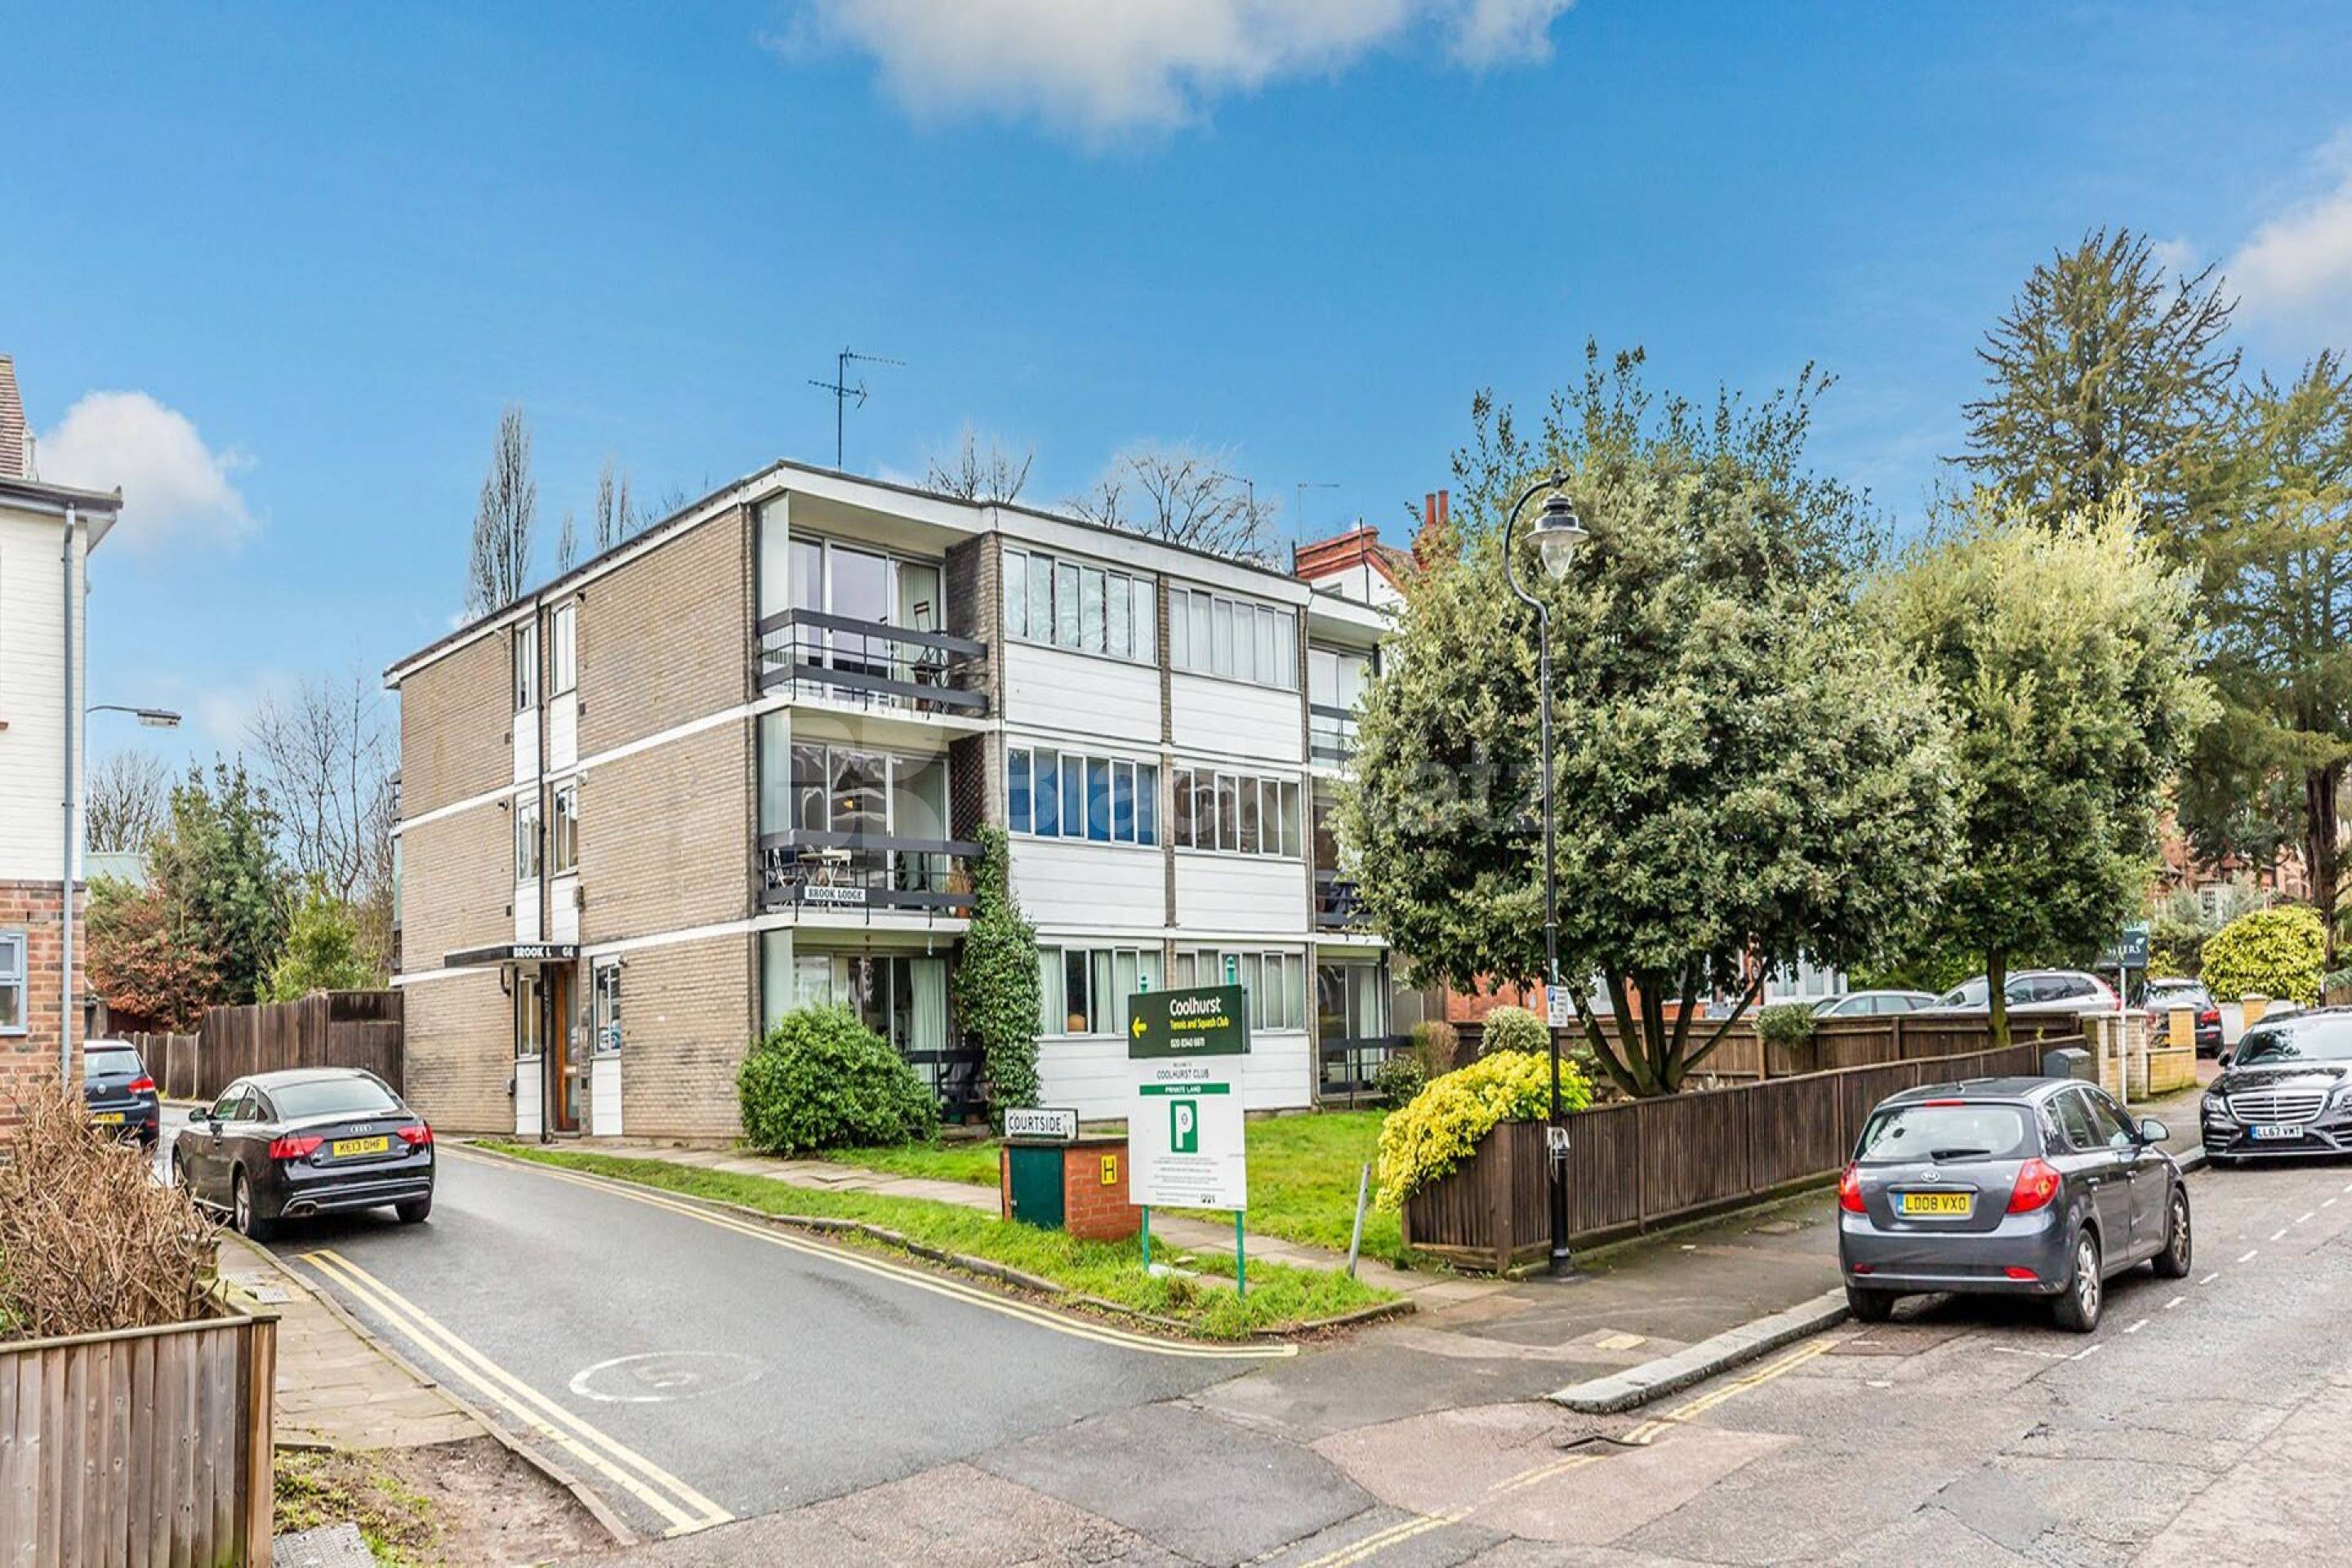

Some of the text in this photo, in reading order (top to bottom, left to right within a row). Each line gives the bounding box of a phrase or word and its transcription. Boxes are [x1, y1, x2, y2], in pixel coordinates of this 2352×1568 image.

[808, 888, 863, 900] BROOK LODGE
[514, 947, 545, 958] BROOK
[1169, 996, 1222, 1017] Coolhurst
[1187, 1018, 1197, 1029] and
[1217, 1016, 1230, 1027] Club
[1156, 1068, 1209, 1080] COOLHURST CLUB
[1009, 1115, 1062, 1132] COURTSIDE
[1104, 1158, 1116, 1181] H
[1940, 1193, 1967, 1210] VXO
